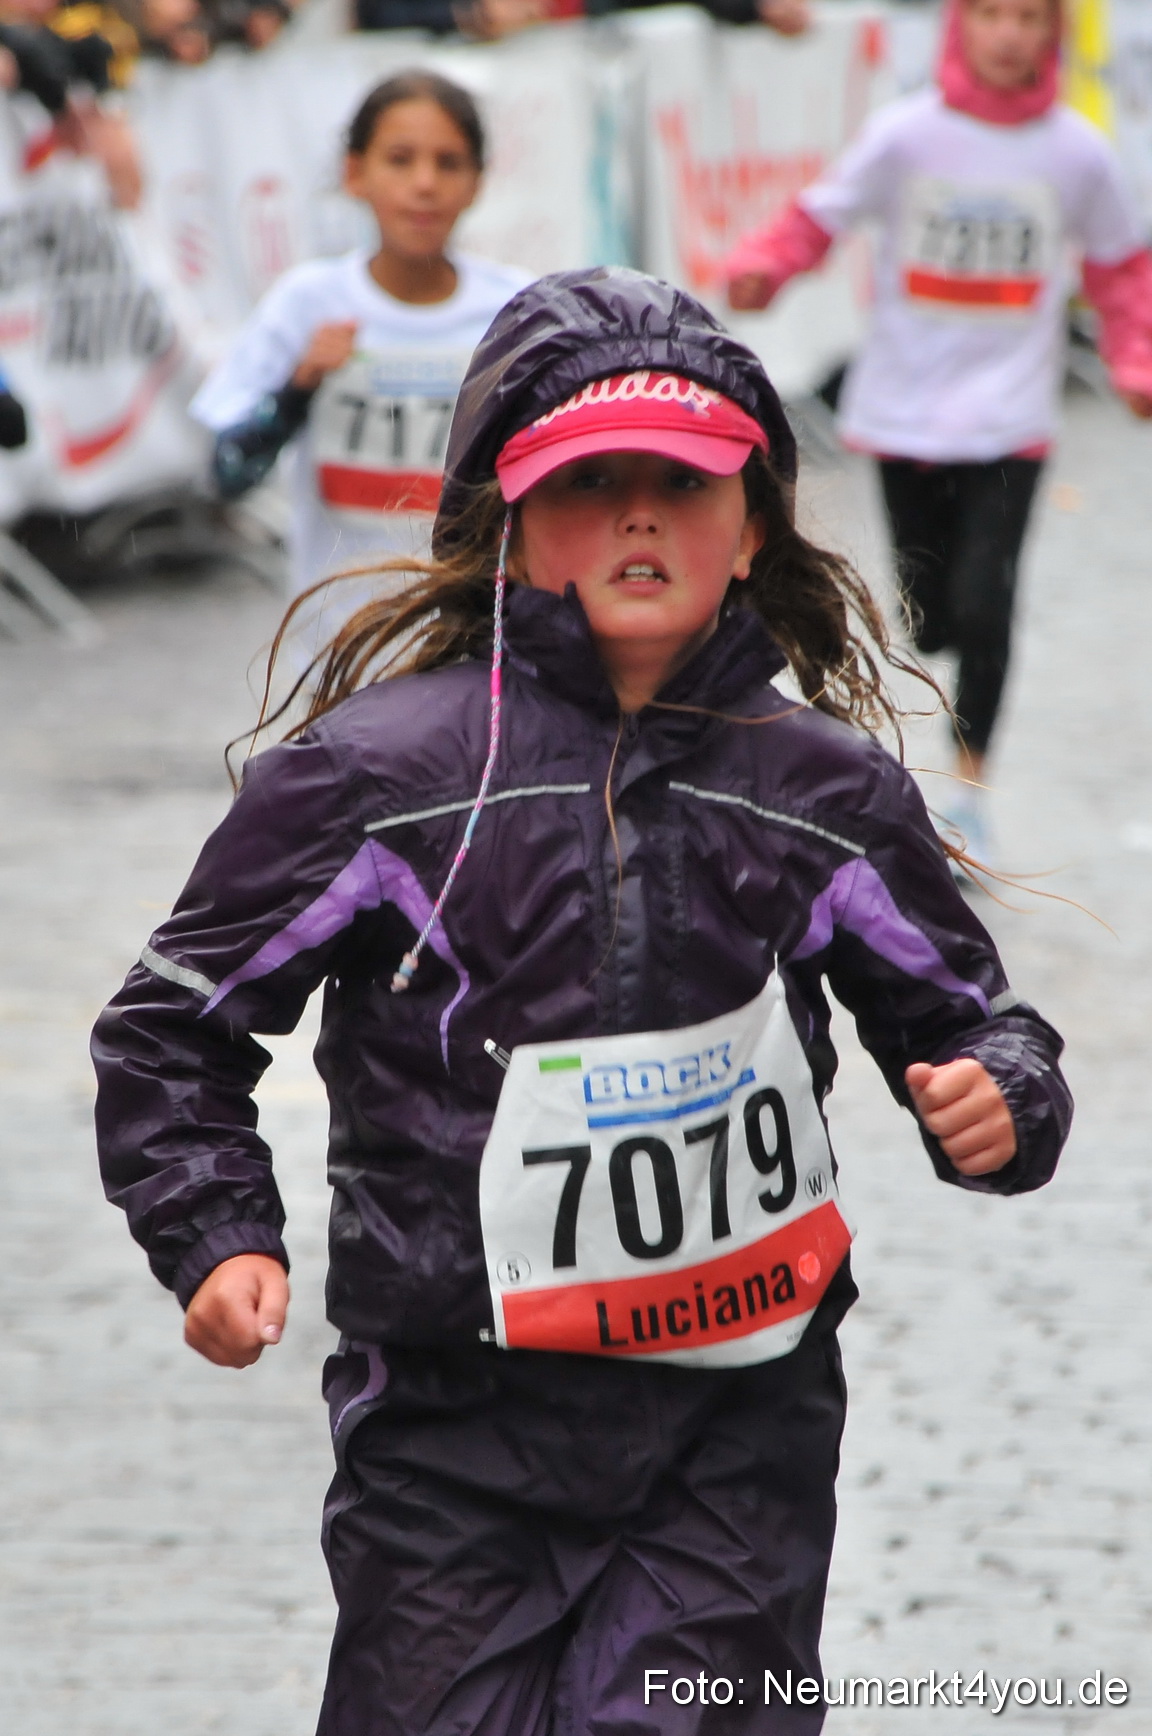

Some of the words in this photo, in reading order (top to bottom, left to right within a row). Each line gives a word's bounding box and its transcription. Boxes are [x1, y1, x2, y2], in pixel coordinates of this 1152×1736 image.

[337, 394, 456, 460] 717
[582, 1041, 732, 1105] BOCK
[521, 1086, 798, 1271] 7079
[807, 1174, 822, 1197] W
[595, 1263, 796, 1347] Luciana
